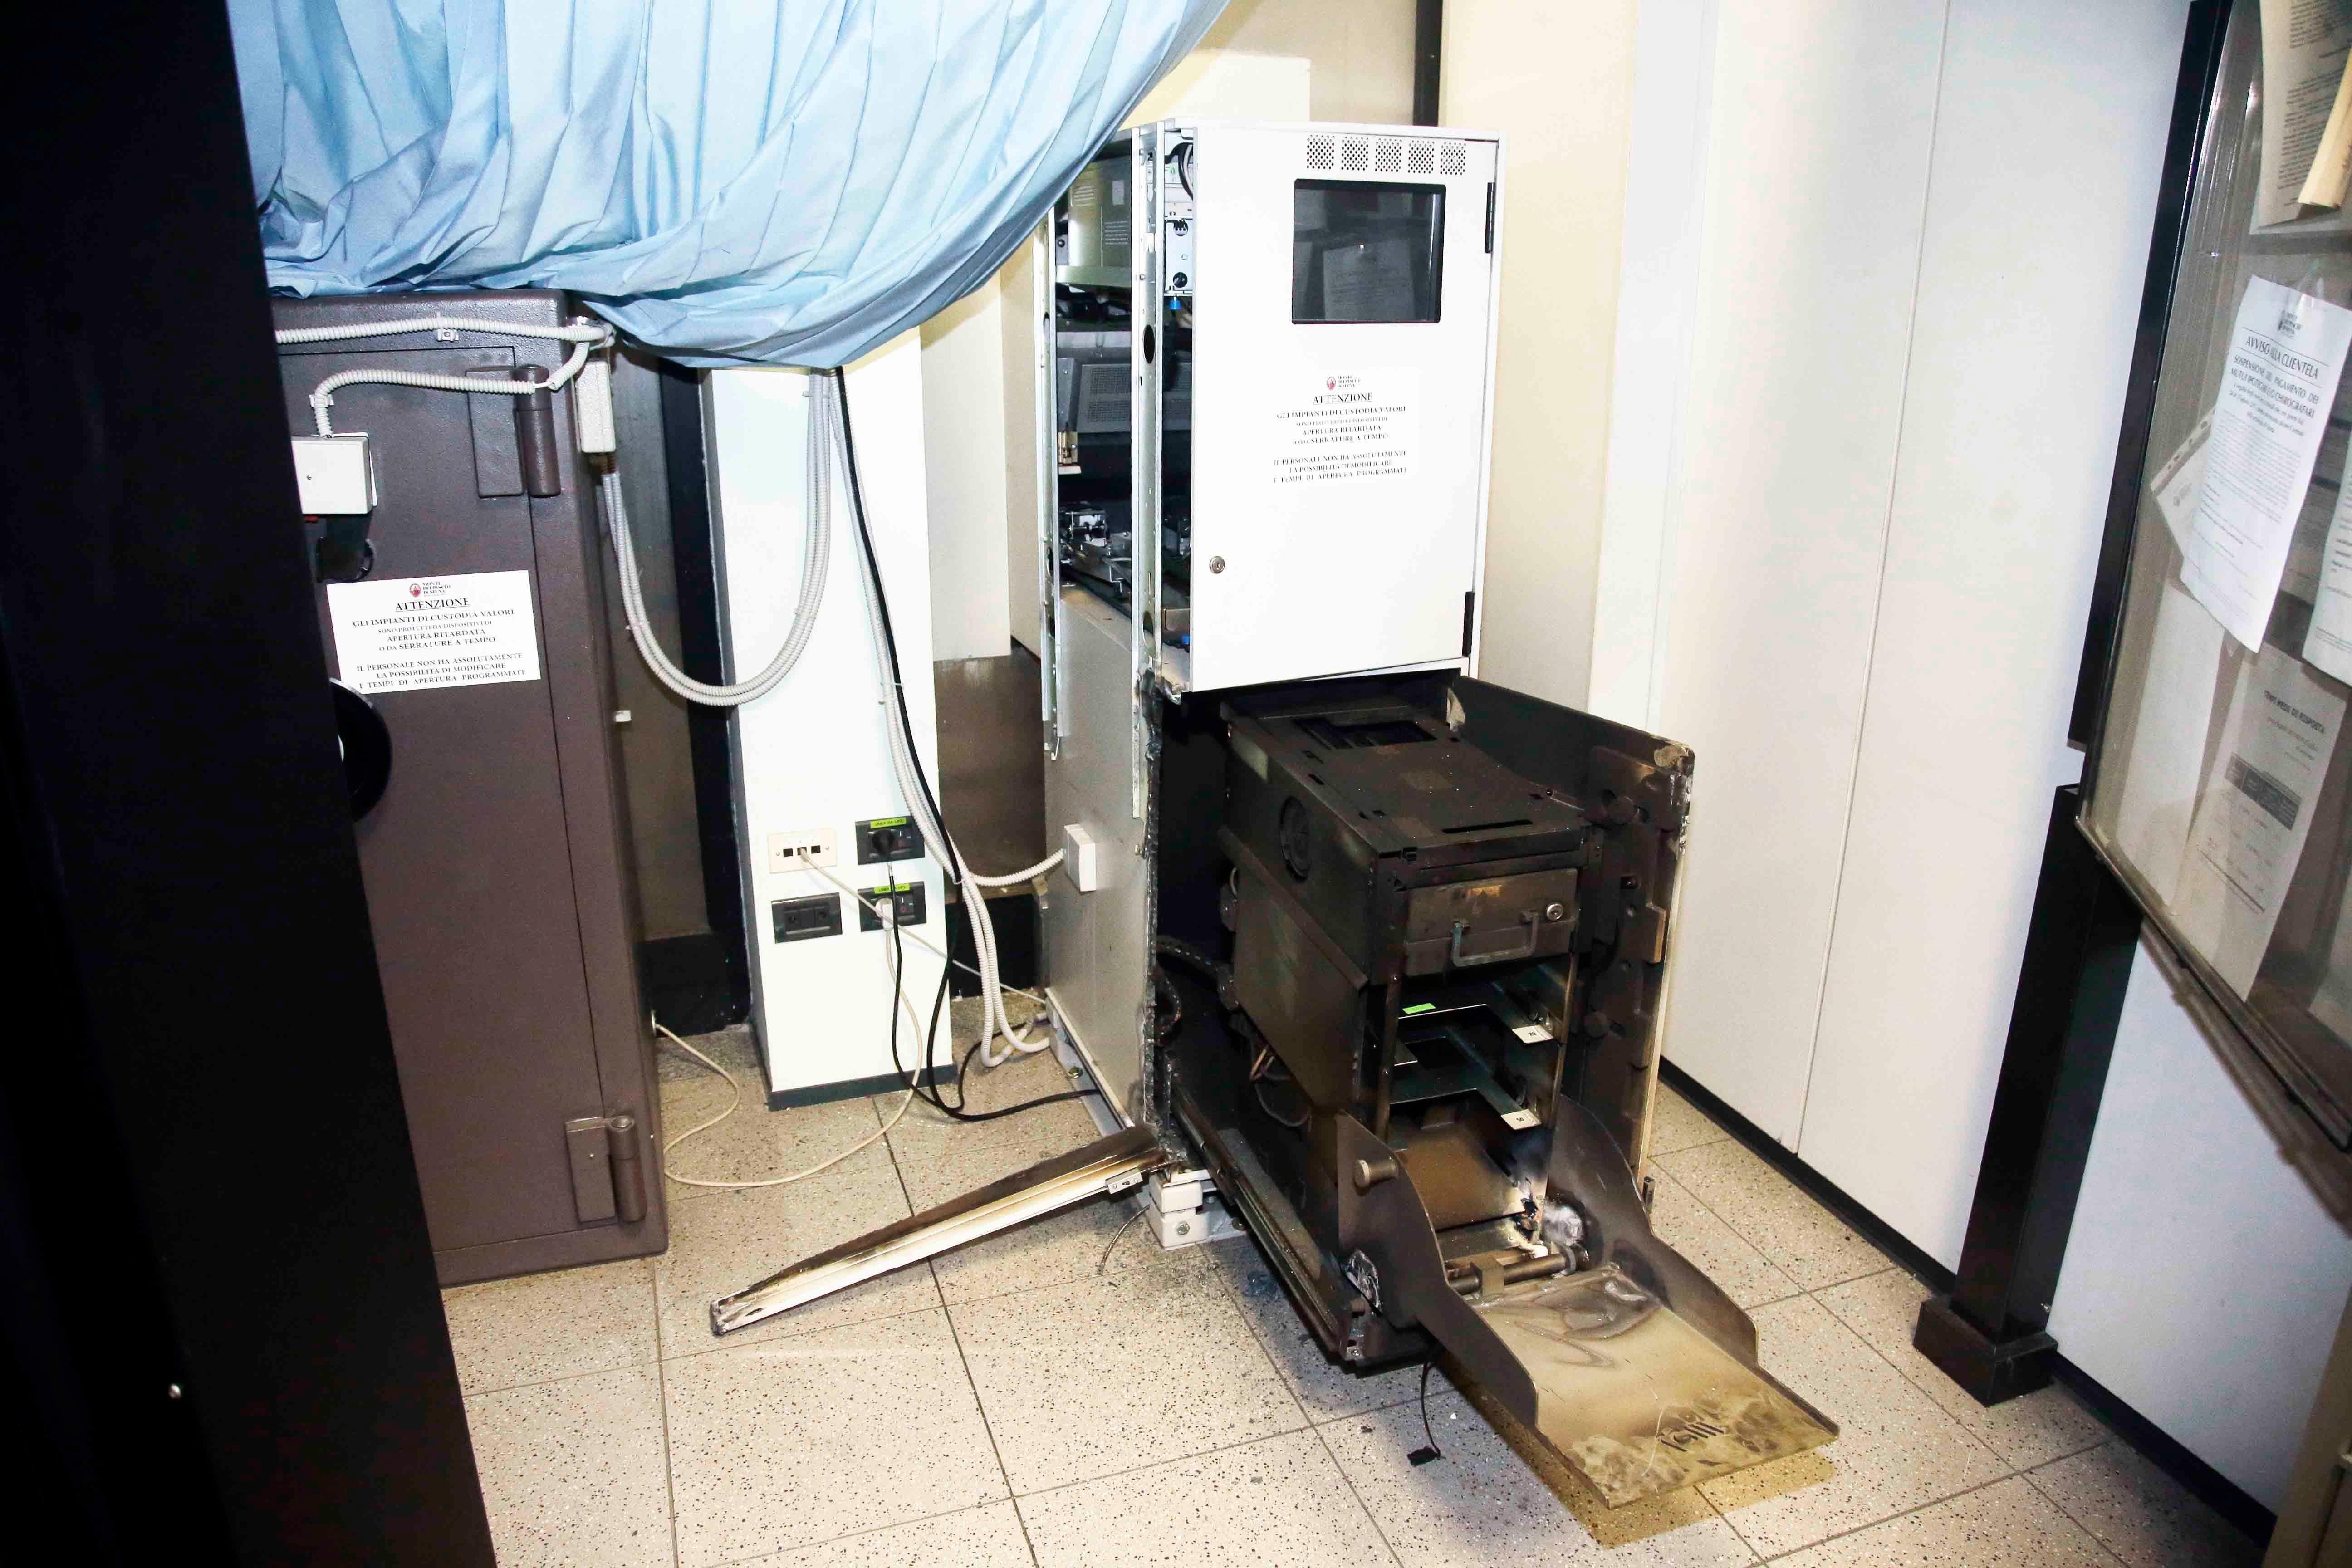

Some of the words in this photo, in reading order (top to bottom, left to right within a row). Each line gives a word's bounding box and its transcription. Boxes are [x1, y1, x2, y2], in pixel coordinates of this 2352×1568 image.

[2246, 336, 2269, 354] AVVISO
[2281, 353, 2318, 380] CLIENTELA
[1313, 392, 1372, 403] ATTENZIONE
[1292, 410, 1328, 418] IMPIANTI
[1340, 425, 1381, 433] RITARDATA
[1311, 435, 1352, 443] SERRATURE
[1283, 456, 1321, 465] PERSONALE
[1352, 450, 1406, 460] ASSOLUTAMENTE
[1351, 460, 1391, 468] MODIFICARE
[1281, 475, 1302, 483] TEMPI
[1318, 471, 1353, 480] APERTURA
[1357, 466, 1406, 476] PROGRAMMATI
[396, 597, 469, 611] ATTENZIONE
[371, 617, 415, 625] IMPIANTI
[430, 612, 478, 621] CUSTODIA
[444, 621, 483, 629] DISPOSITIVI
[387, 632, 431, 642] APERTURA
[434, 629, 485, 638] RITARDATA
[399, 640, 452, 650] SERRATURE
[464, 636, 495, 644] TEMPO
[367, 661, 414, 671] PERSONALE
[453, 653, 523, 664] ASSOLUTAMENTE
[453, 662, 506, 672] MODIFICARE
[413, 676, 457, 685] APERTURA
[462, 669, 525, 680] PROGRAMMATI
